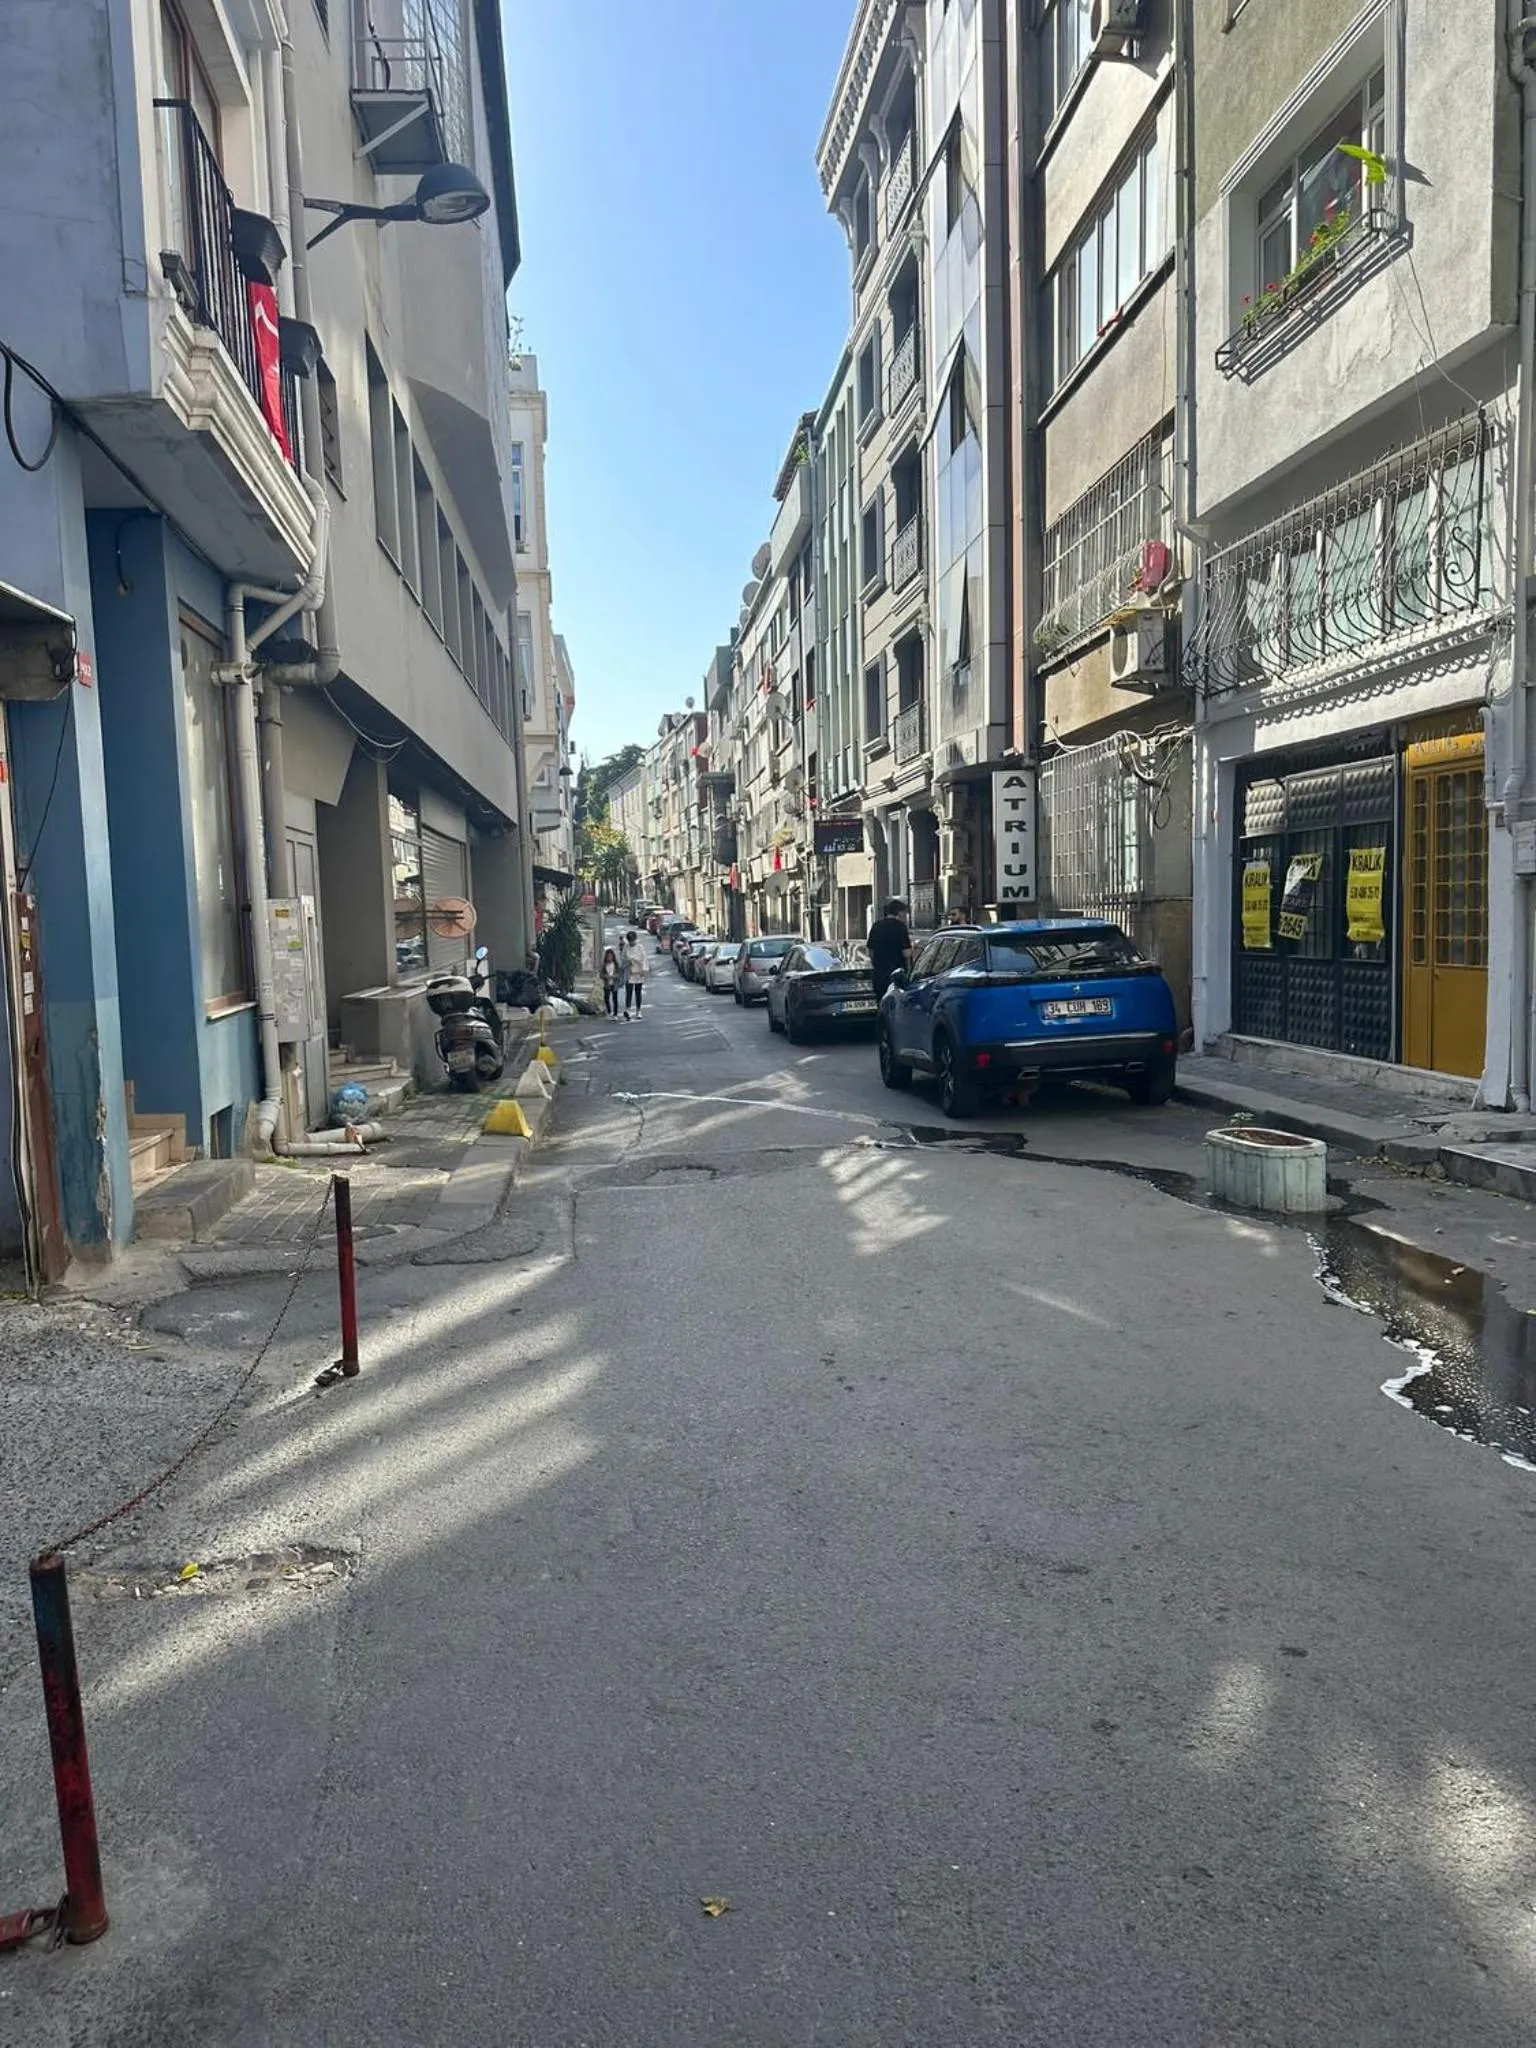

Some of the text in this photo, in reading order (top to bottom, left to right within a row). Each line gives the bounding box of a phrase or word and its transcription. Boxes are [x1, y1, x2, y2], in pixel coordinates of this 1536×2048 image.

[1002, 775, 1030, 898] ATRIUM
[1279, 915, 1304, 937] 2645
[1048, 1002, 1061, 1014] 34
